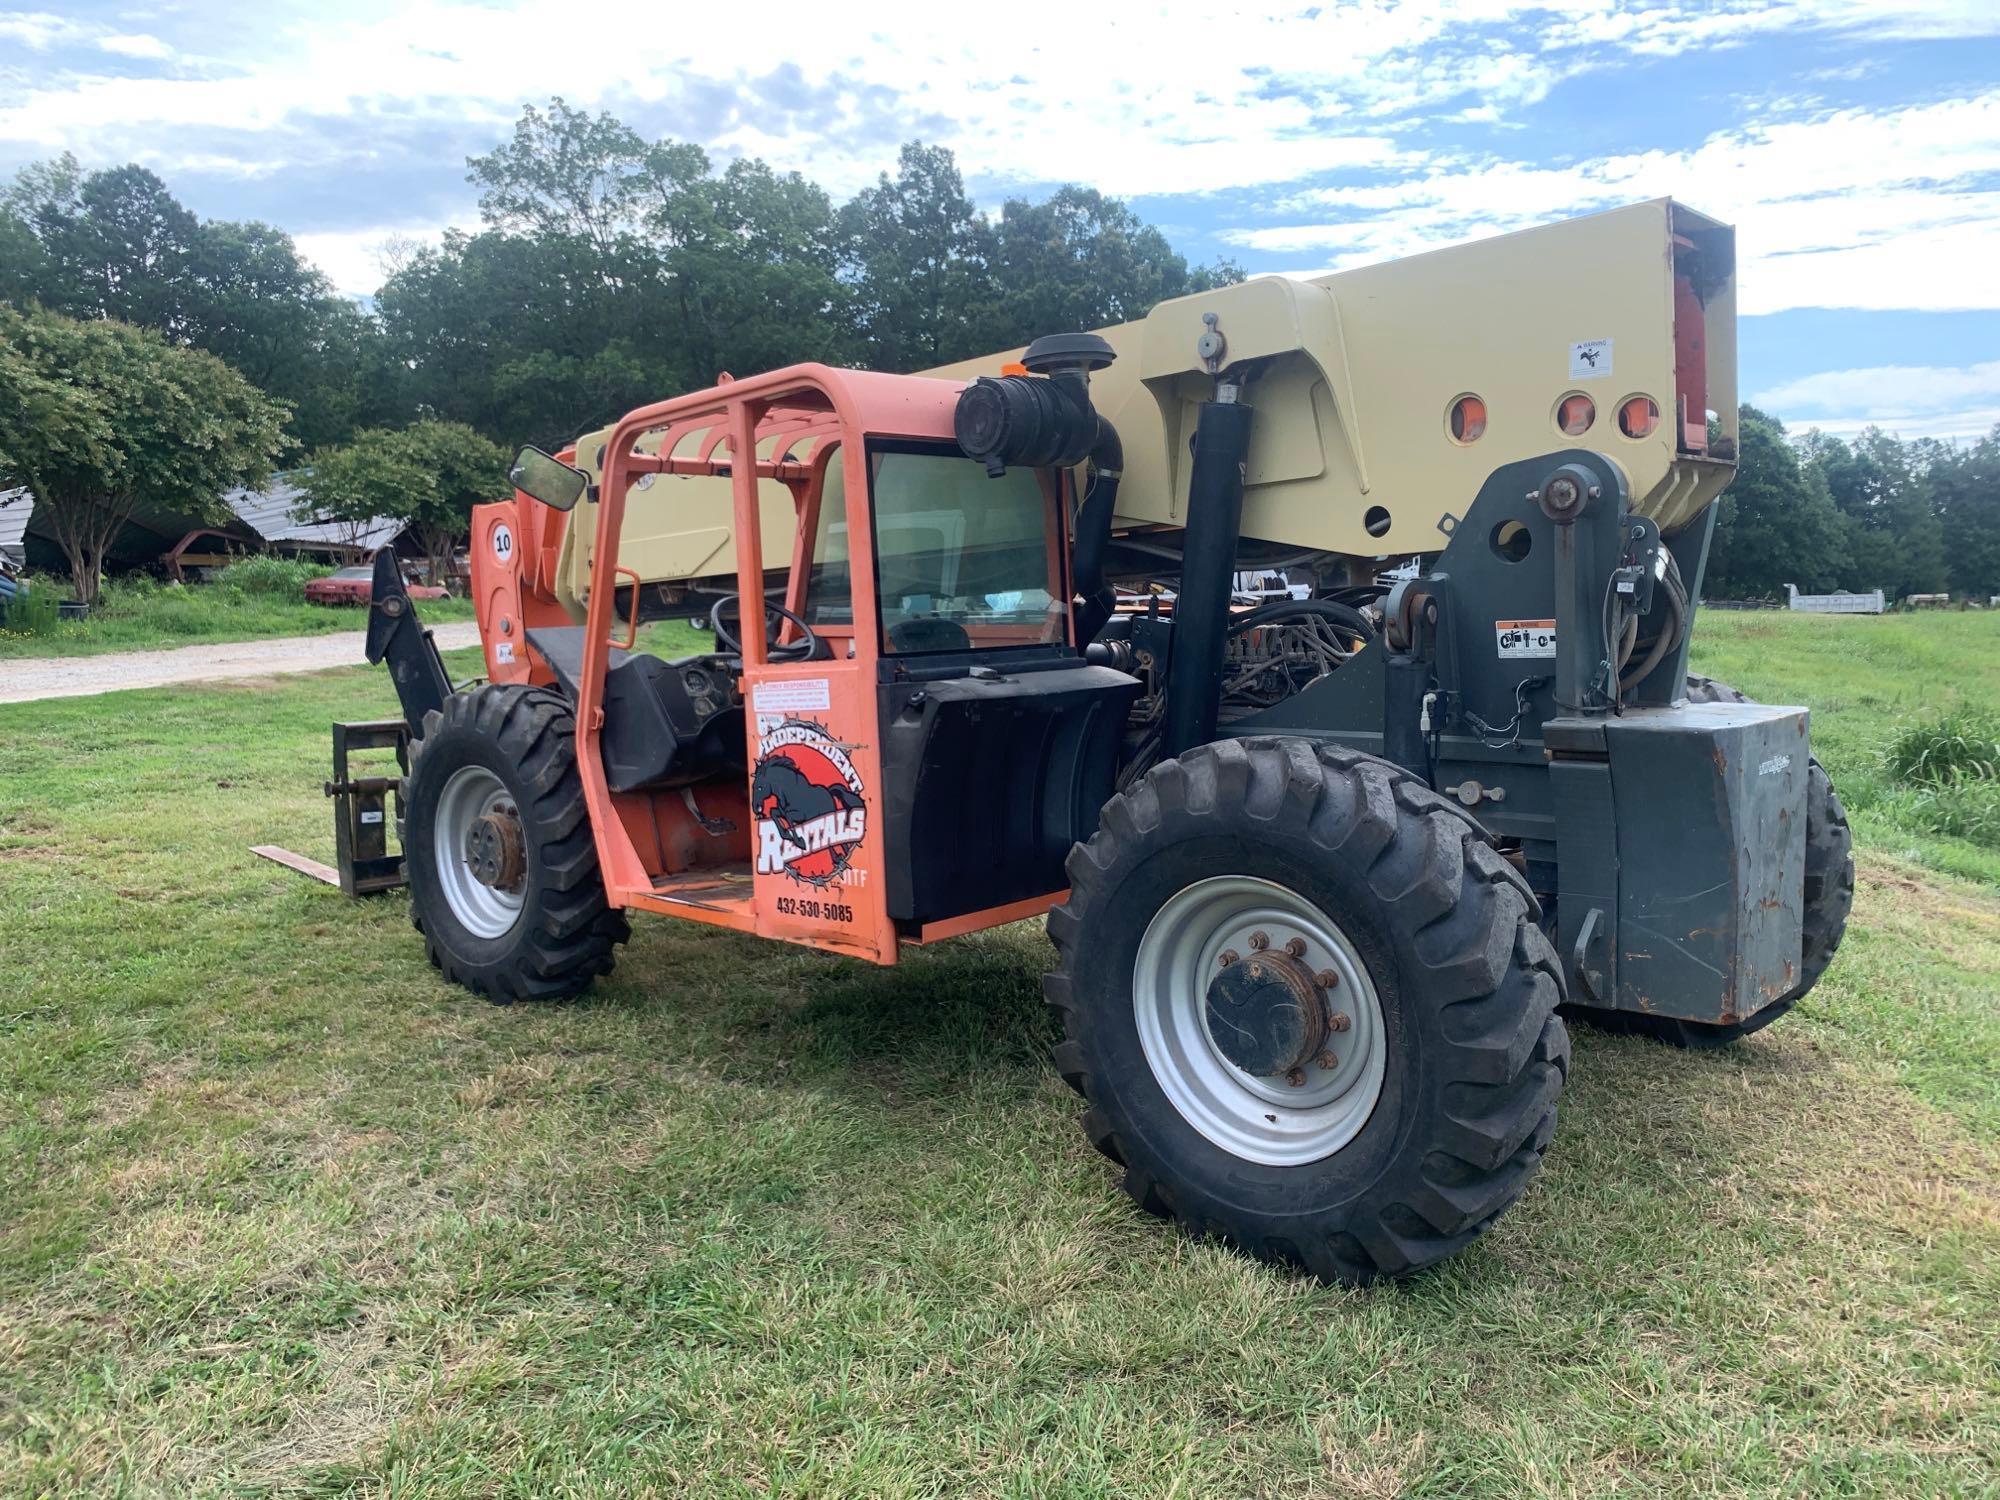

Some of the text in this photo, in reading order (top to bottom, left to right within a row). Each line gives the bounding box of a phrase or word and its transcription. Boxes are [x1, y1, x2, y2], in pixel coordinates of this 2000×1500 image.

[496, 534, 511, 552] 10
[759, 726, 864, 794] INDEPENDENT
[757, 808, 866, 874] RENTALS
[777, 897, 853, 923] 432-530-5085
